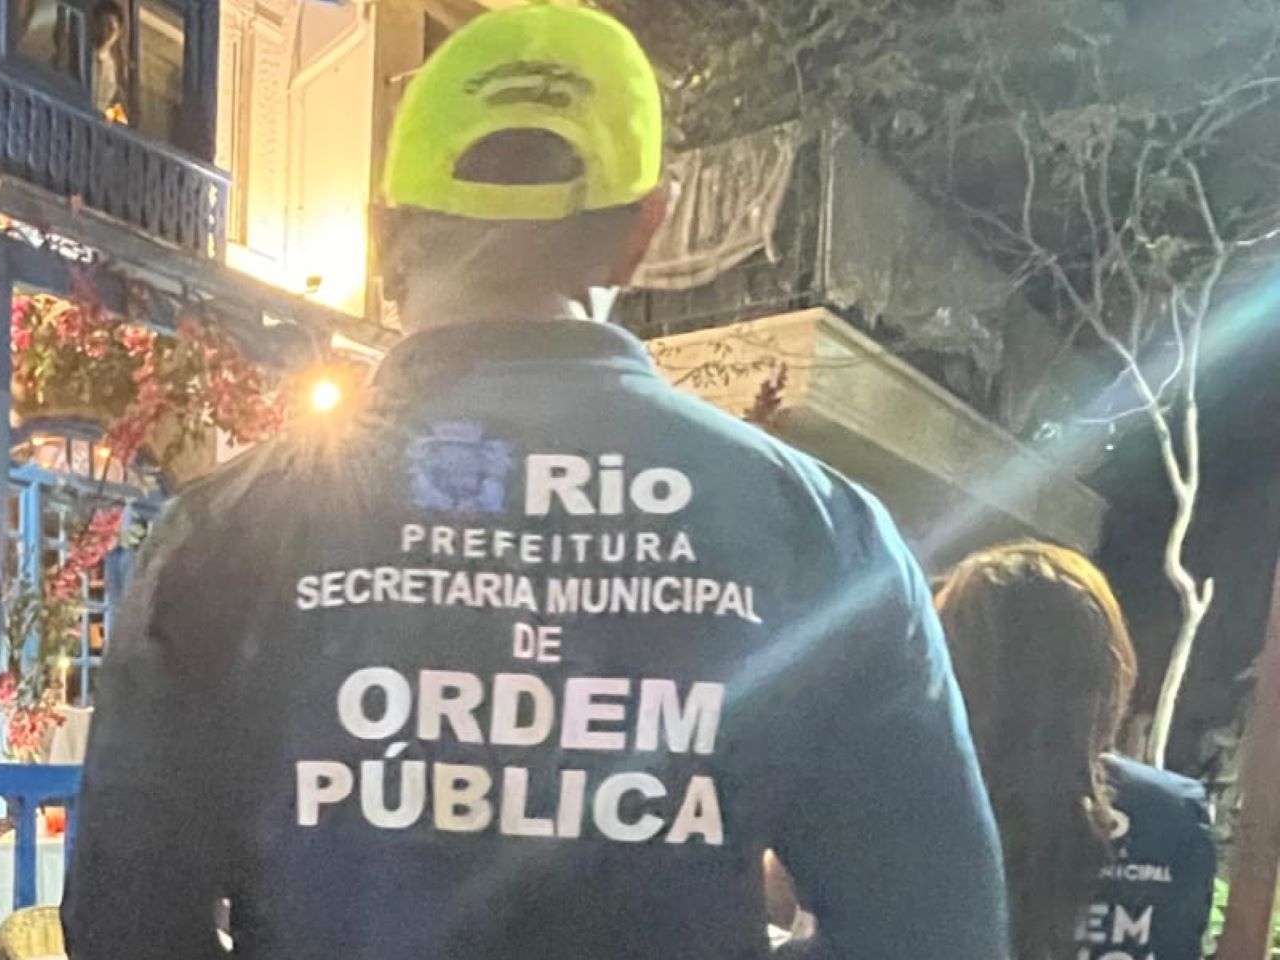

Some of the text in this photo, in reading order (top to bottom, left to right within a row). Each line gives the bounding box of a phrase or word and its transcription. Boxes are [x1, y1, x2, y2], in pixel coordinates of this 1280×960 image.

[523, 453, 694, 516] Rio
[402, 523, 696, 563] PREFEITURA
[296, 566, 763, 624] SECRETARIA MUNICIPAL
[512, 622, 563, 663] DE
[336, 666, 726, 755] ORDEM
[295, 741, 725, 846] PÚBLICA
